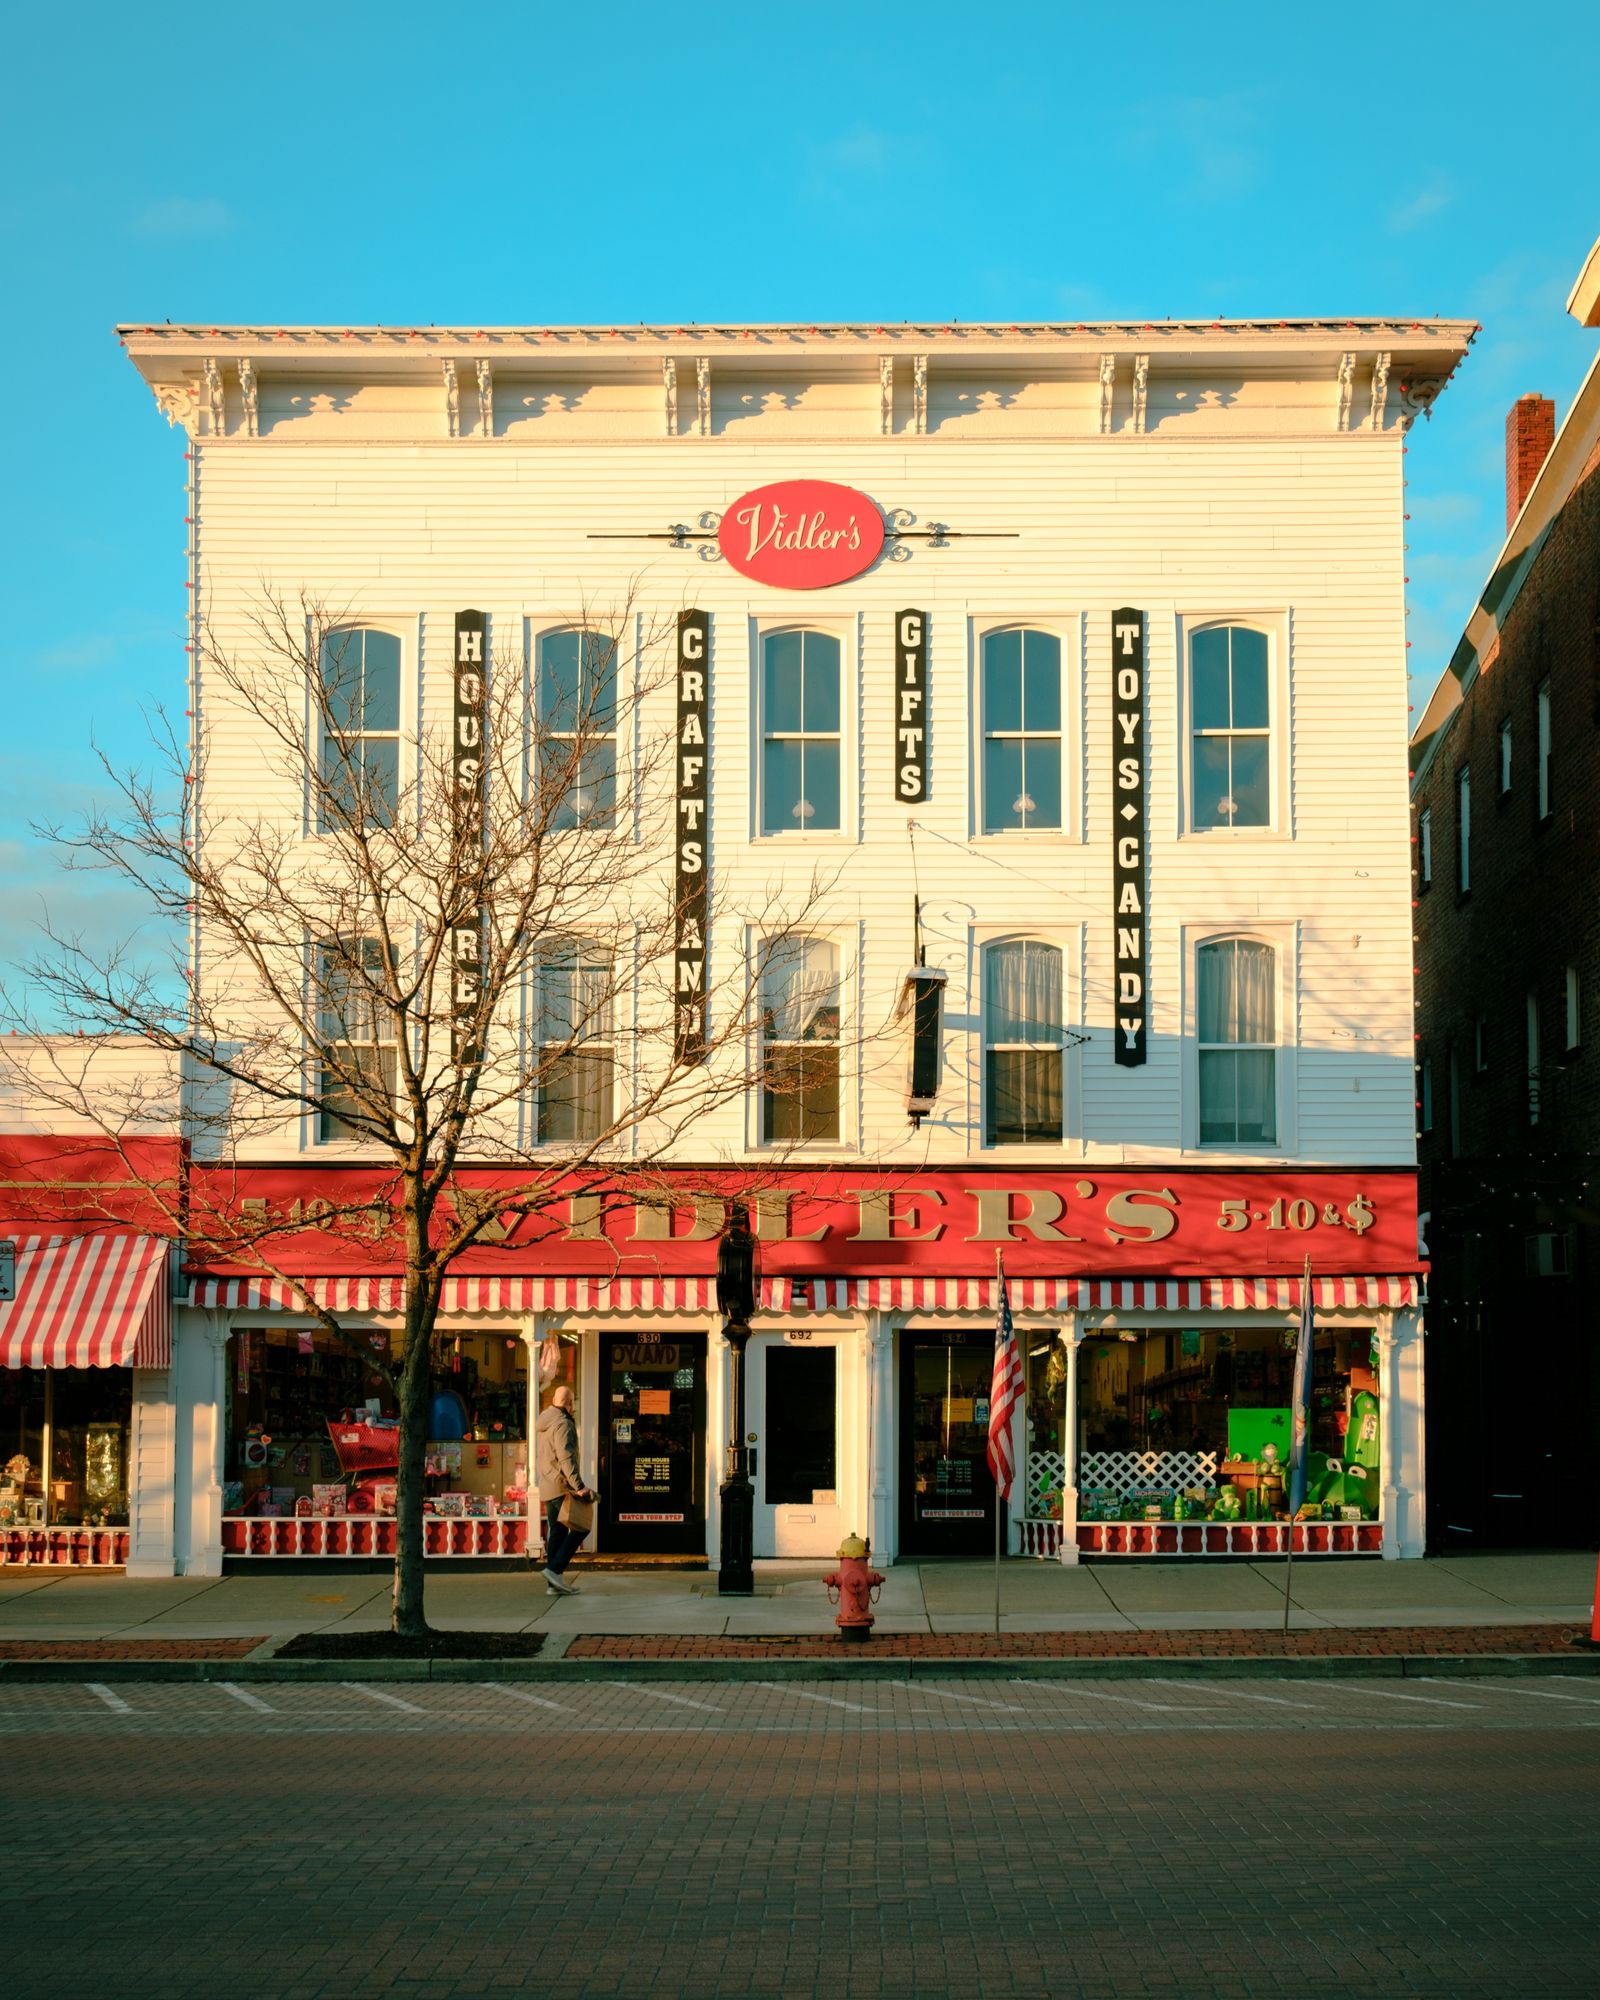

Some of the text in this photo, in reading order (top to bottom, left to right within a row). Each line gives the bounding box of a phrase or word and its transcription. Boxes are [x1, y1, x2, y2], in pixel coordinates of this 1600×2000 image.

[737, 503, 862, 562] Vidler's
[899, 616, 923, 797] GIFTS
[679, 628, 704, 1034] CRAFTS AND
[1116, 624, 1142, 1050] TOYS CANDY
[439, 1180, 1180, 1244] VIDLER'S
[638, 1333, 660, 1343] 690
[790, 1330, 812, 1340] 692
